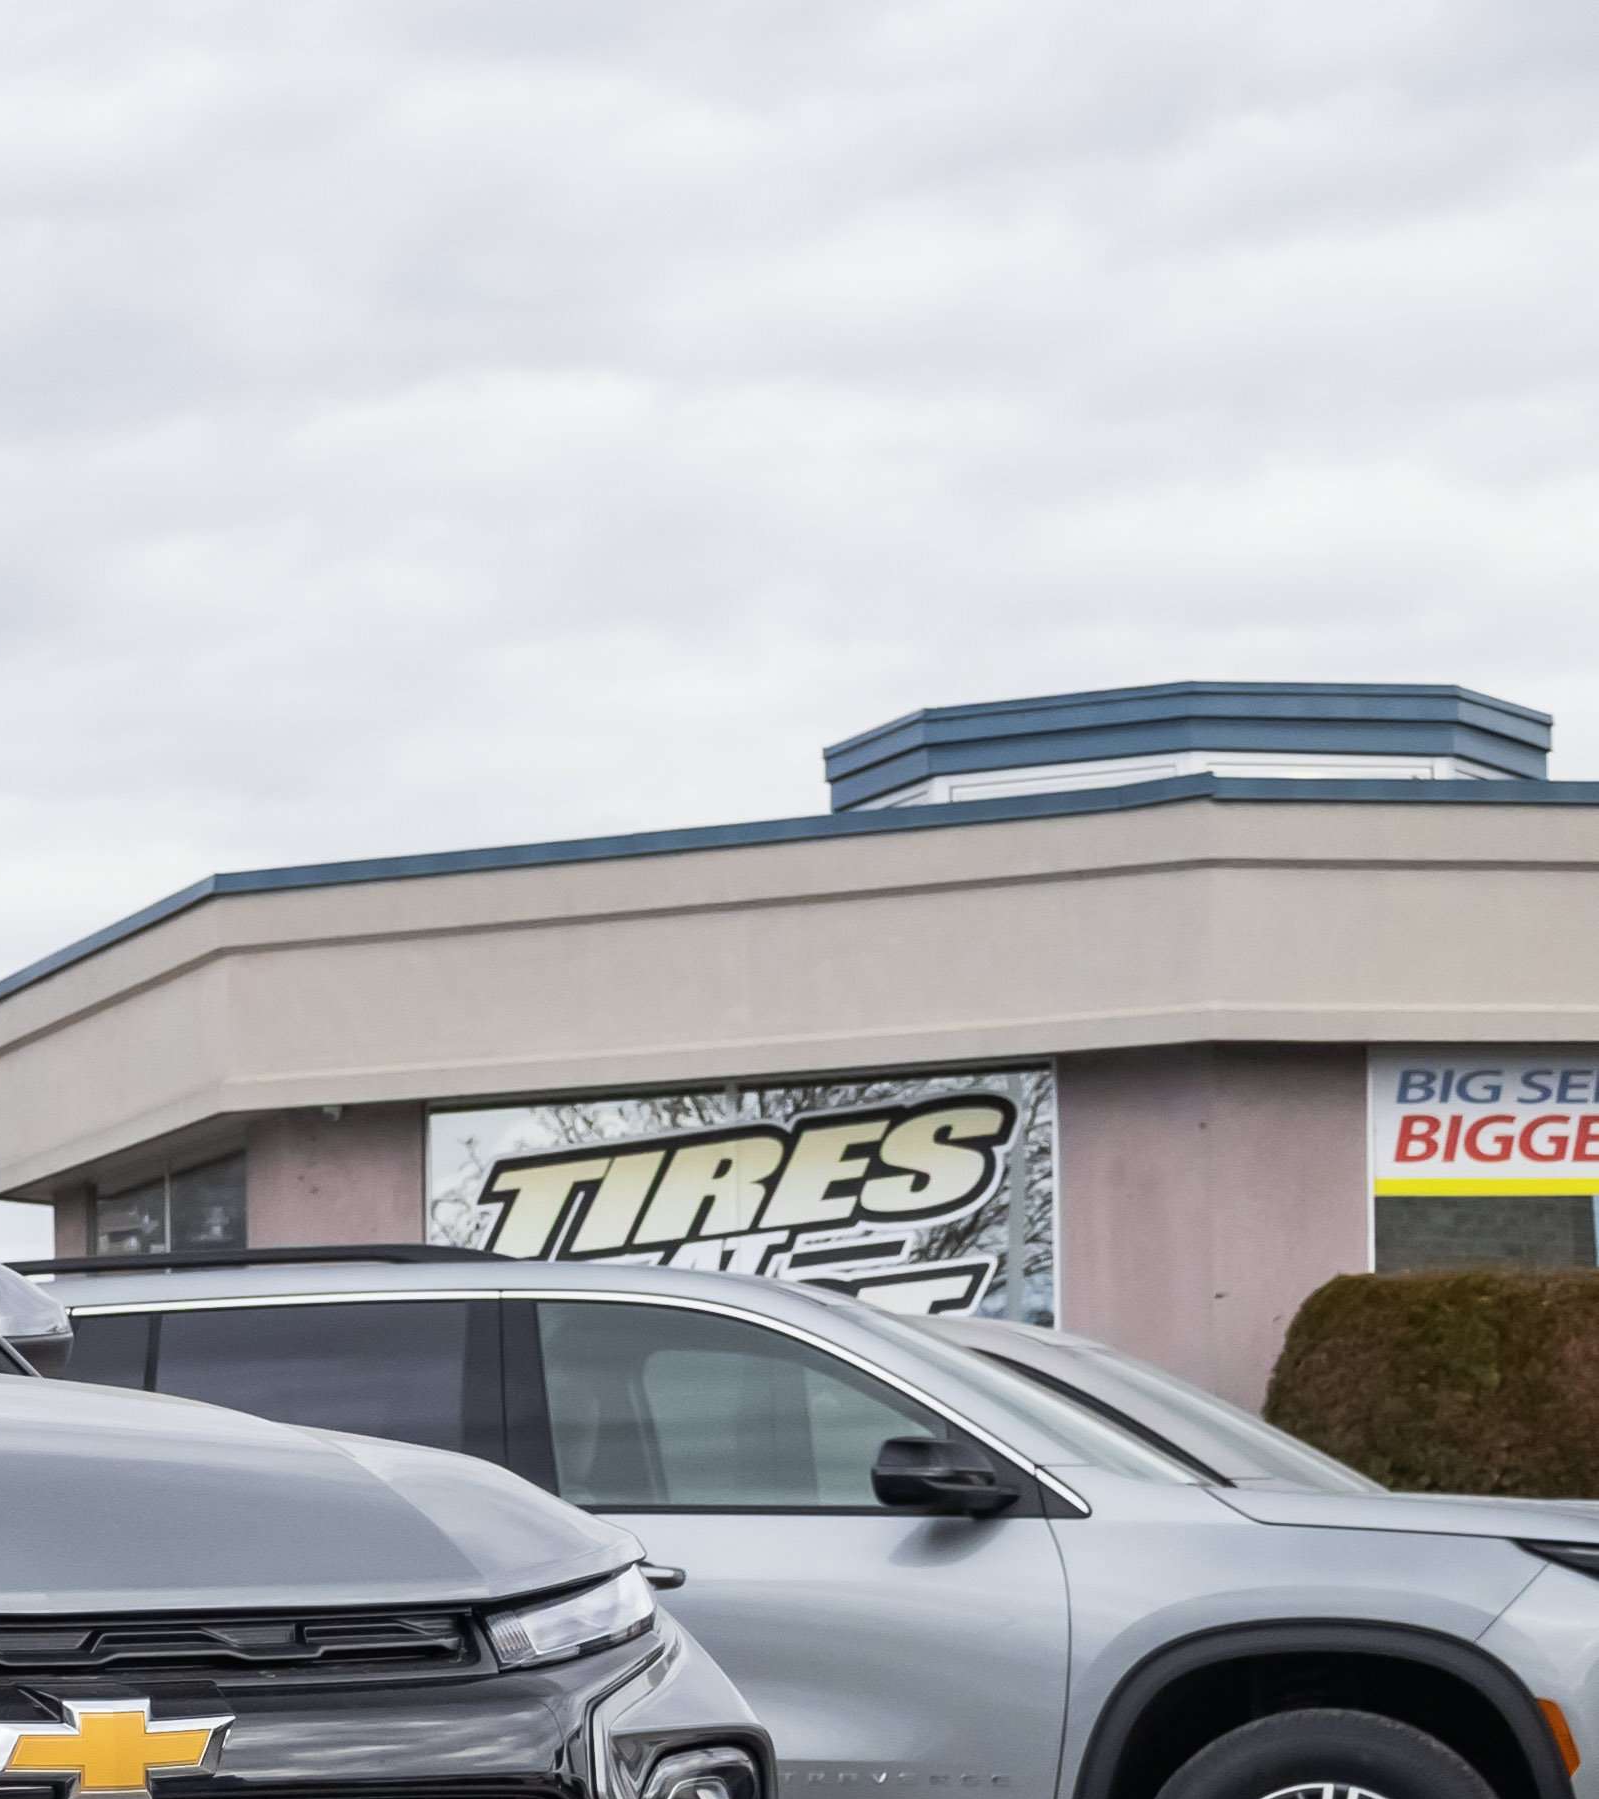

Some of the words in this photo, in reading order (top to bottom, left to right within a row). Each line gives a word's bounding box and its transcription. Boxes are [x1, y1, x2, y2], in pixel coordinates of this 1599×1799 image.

[1396, 1069, 1504, 1104] BIG
[1517, 1069, 1599, 1105] SE
[481, 1097, 1015, 1258] TIRES
